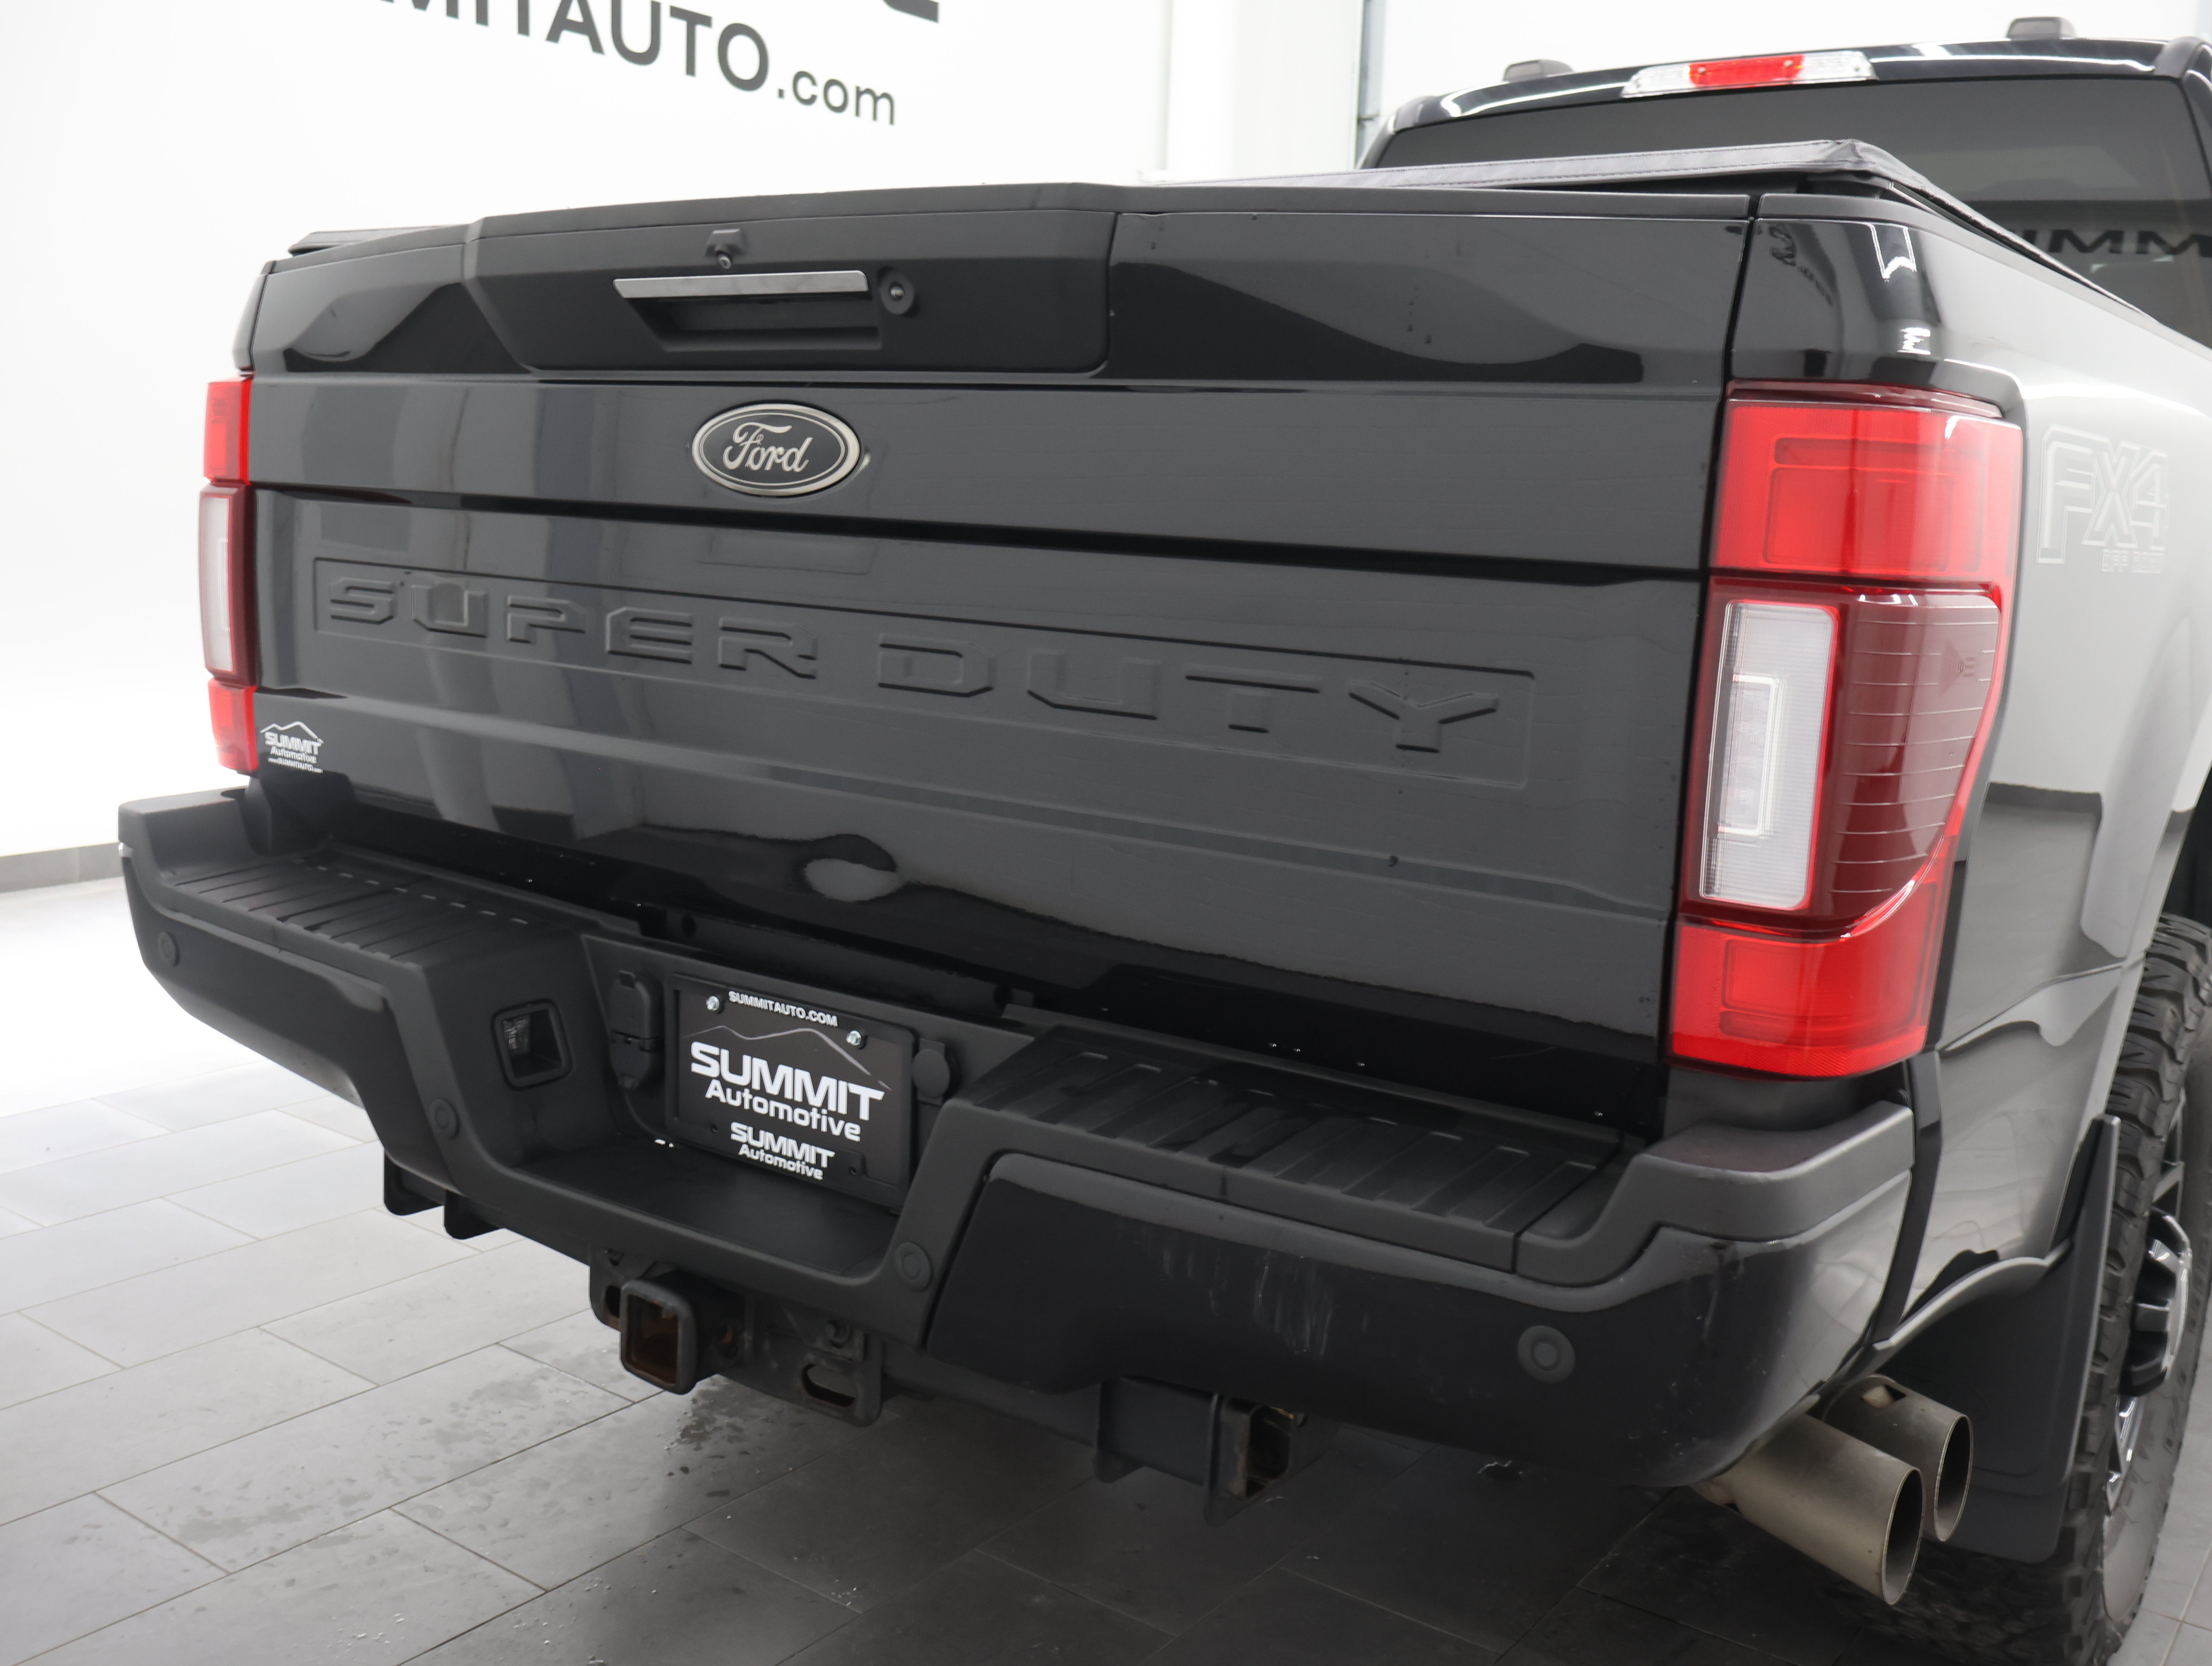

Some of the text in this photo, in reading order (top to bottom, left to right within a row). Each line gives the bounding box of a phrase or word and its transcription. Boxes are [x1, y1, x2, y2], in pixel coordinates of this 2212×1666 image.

[722, 422, 813, 472] Ford
[2035, 423, 2170, 564] FX4
[329, 576, 1499, 754] SUPER DUTY
[264, 732, 322, 755] SUMMIT
[270, 746, 317, 764] Automotive
[728, 990, 838, 1027] SUMMITAUTO.COM
[691, 1041, 885, 1121] SUMMIT
[705, 1079, 861, 1142] Automotive
[731, 1121, 835, 1168] SUMMIT
[738, 1143, 823, 1180] Automotive
